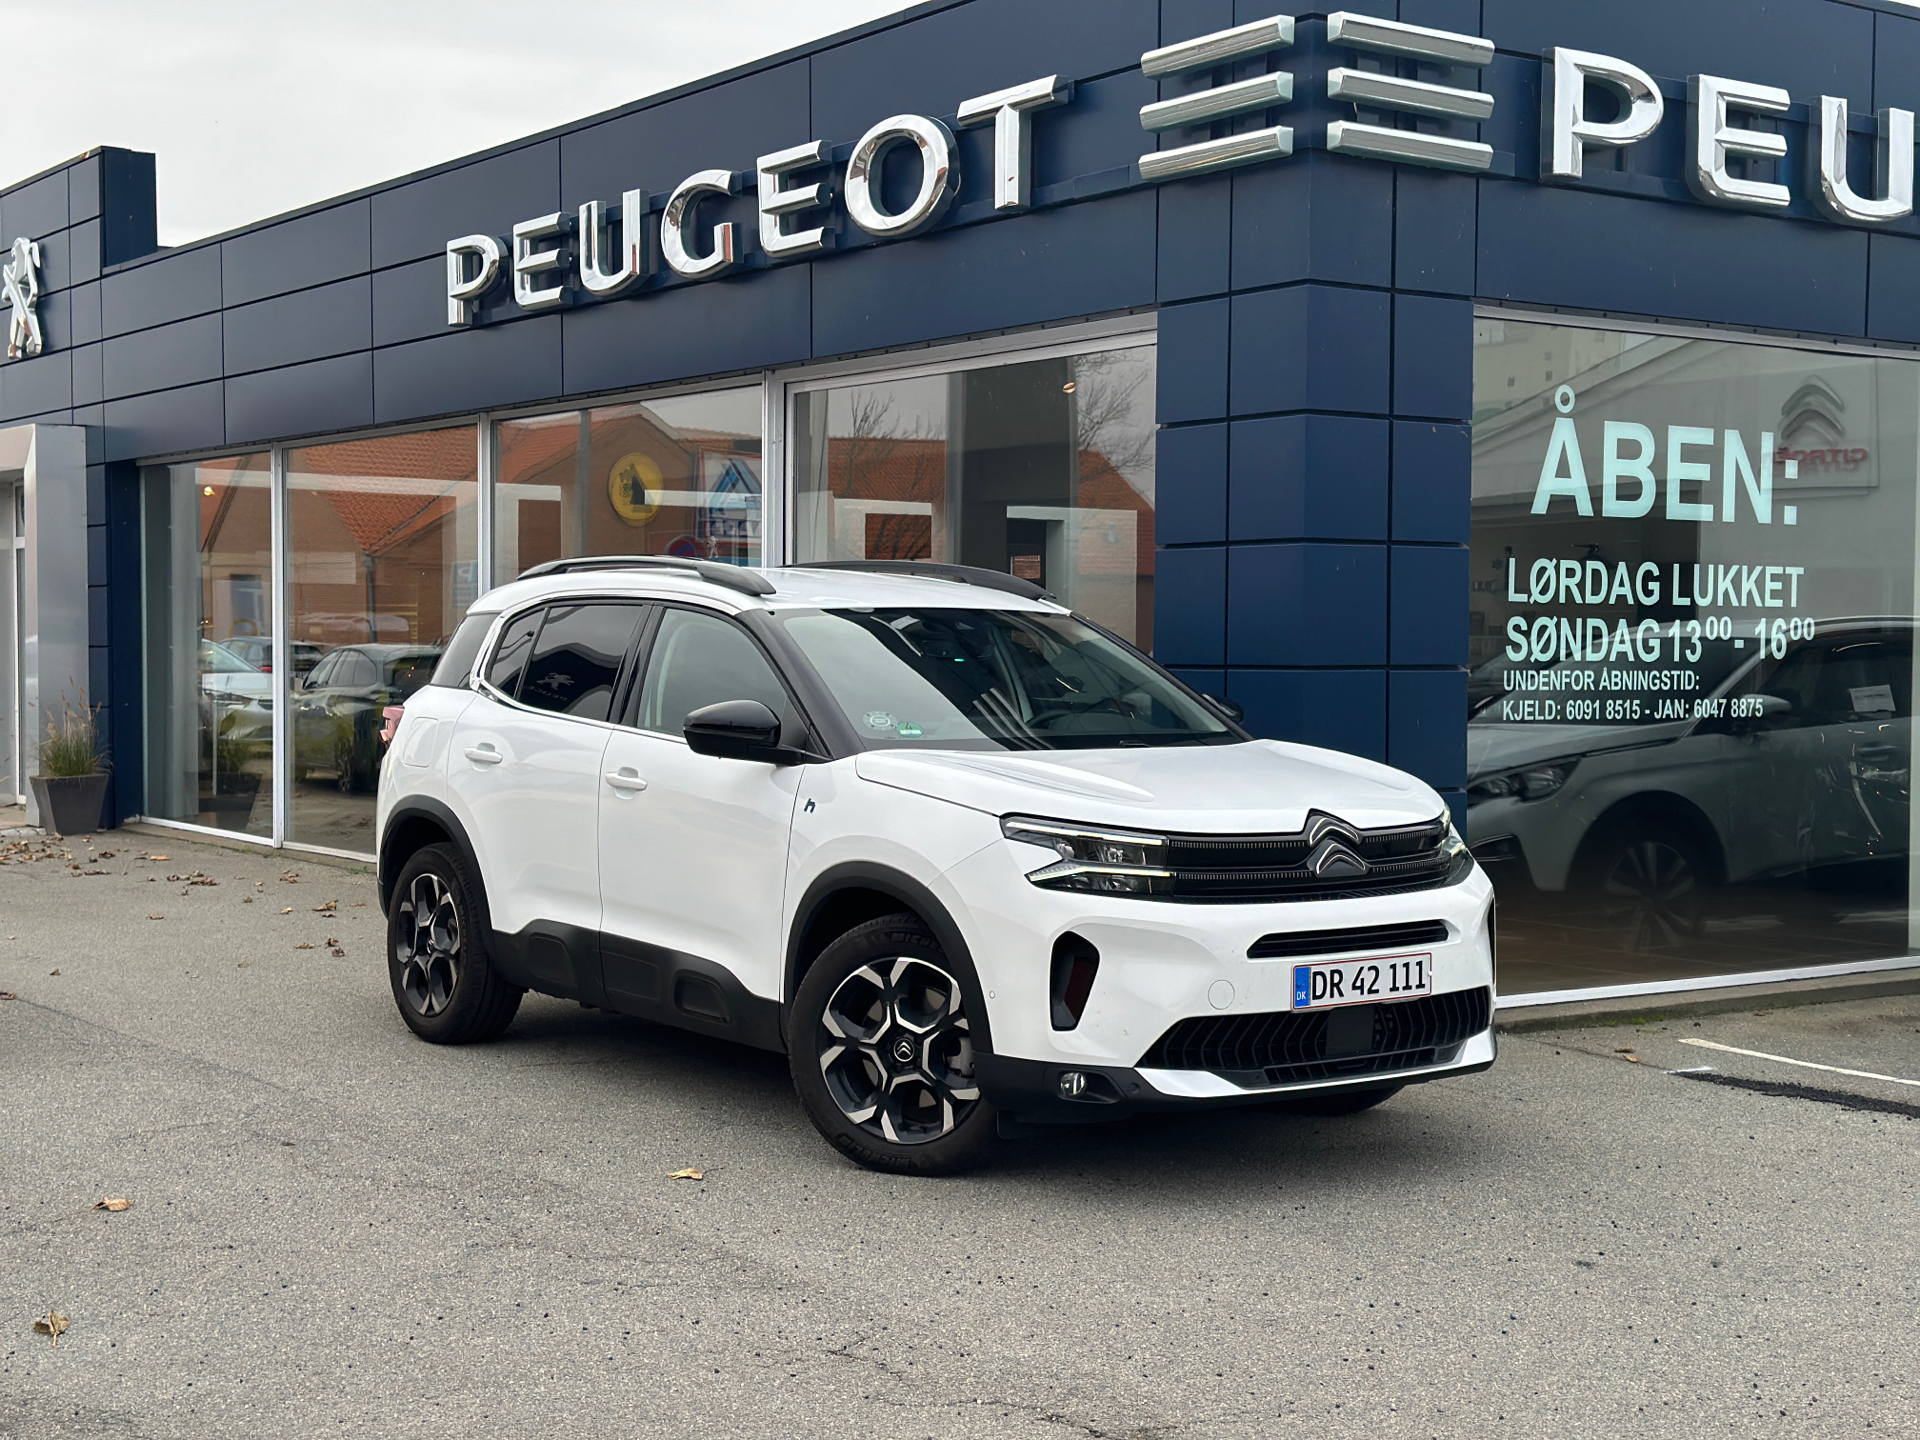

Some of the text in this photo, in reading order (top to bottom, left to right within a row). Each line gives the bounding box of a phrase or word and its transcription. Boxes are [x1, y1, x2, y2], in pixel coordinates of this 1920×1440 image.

[1547, 46, 1915, 222] PEU
[447, 74, 1072, 326] PEUGEOT
[1531, 385, 1797, 525] ÅBEN:
[1507, 557, 1804, 608] LØRDAG LUKKET
[1505, 615, 1661, 664] SØNDAG
[1503, 667, 1700, 692] UNDENFOR ÅBNINGSTID:
[1503, 700, 1561, 721] KJELD:
[1566, 700, 1600, 720] 6091
[1606, 699, 1641, 719] 8515
[1654, 699, 1690, 719] JAN:
[1693, 698, 1727, 719] 6047
[1731, 697, 1764, 718] 8875
[1296, 991, 1307, 1001] DK
[1312, 960, 1426, 1000] DR 42 111
